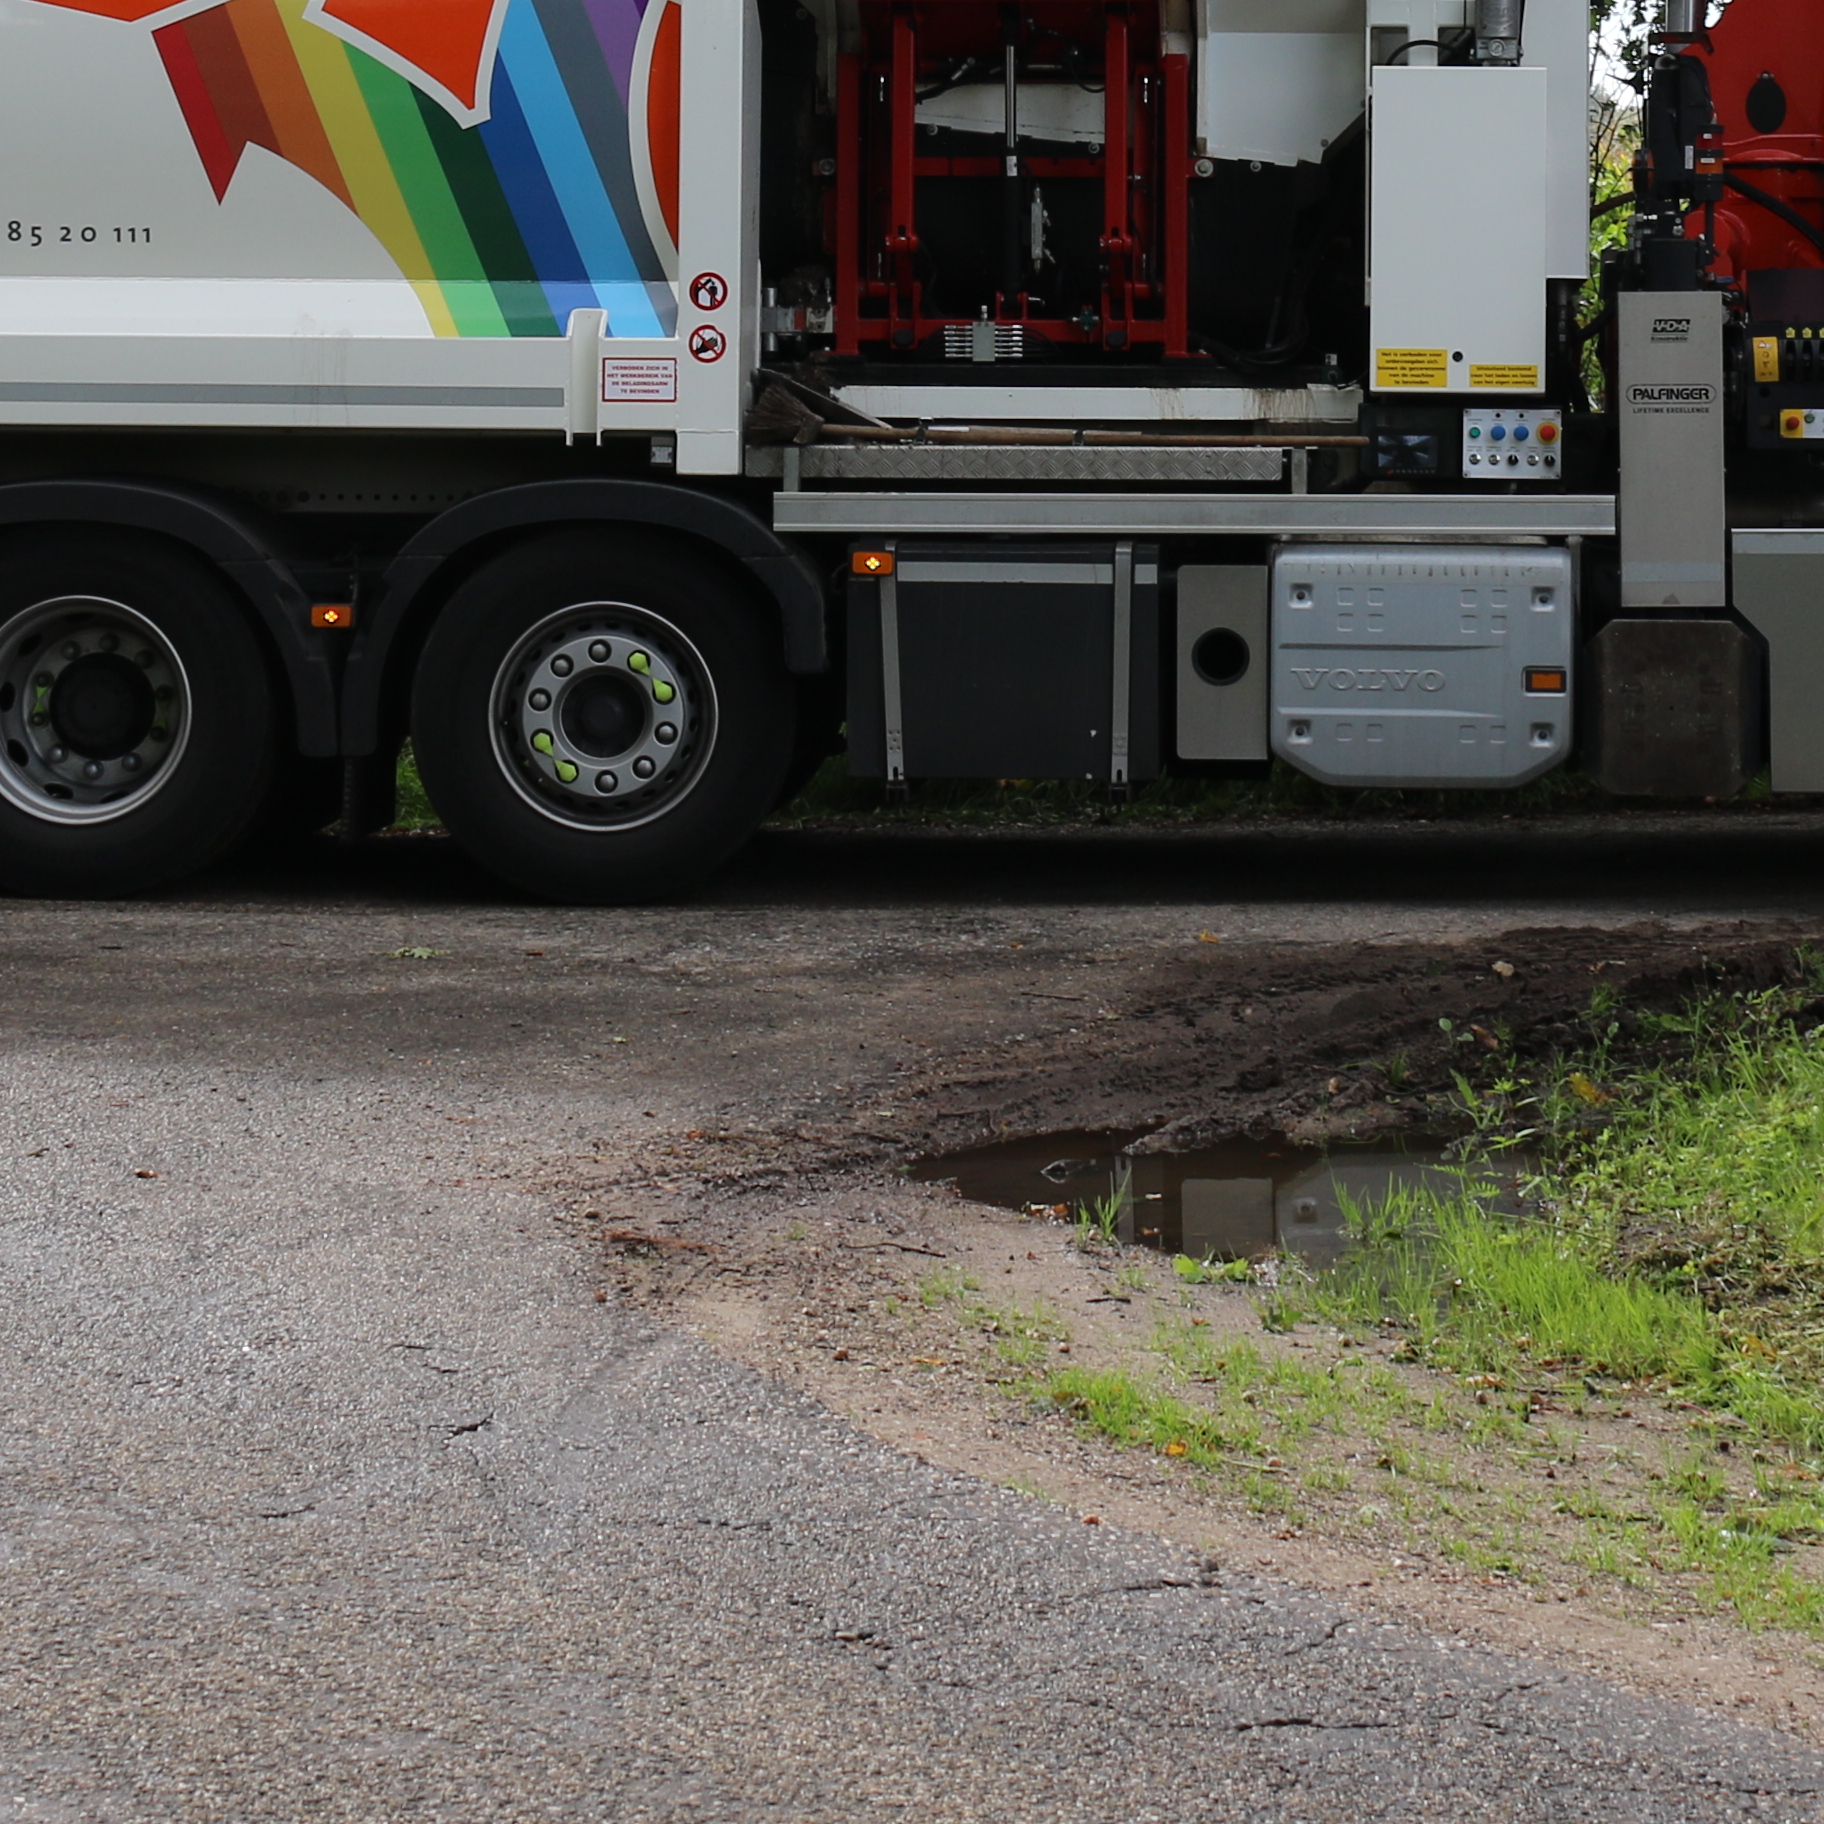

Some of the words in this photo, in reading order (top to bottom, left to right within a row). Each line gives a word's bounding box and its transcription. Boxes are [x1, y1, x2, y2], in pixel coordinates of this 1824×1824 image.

[7, 220, 43, 247] 85
[59, 226, 97, 243] 20
[112, 226, 151, 244] 111
[1633, 388, 1709, 400] PALFINGER
[1290, 667, 1446, 693] VOLVO
